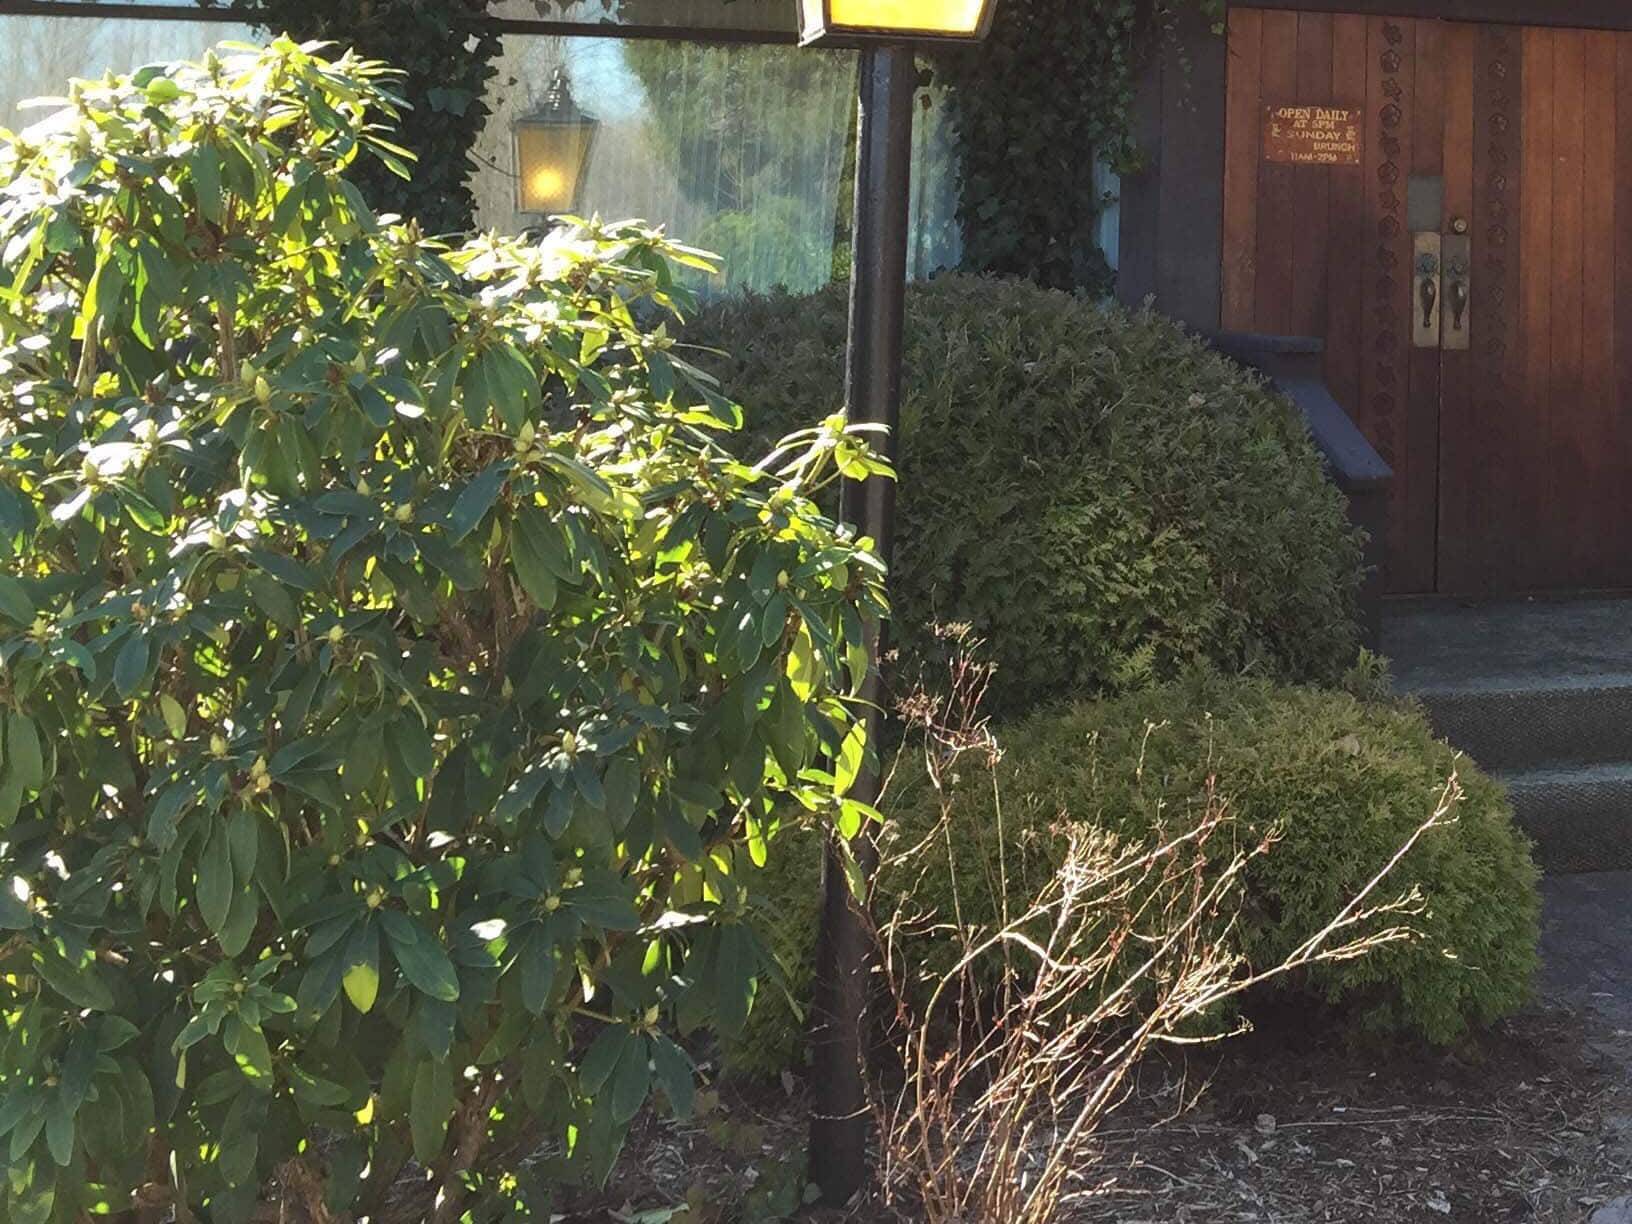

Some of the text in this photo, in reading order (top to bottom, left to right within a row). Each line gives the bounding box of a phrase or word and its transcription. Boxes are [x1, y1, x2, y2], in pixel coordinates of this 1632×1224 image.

[1279, 107, 1349, 121] OPEN DAILY
[1292, 119, 1307, 128] AT
[1286, 130, 1340, 140] SUNDAY
[1313, 142, 1355, 152] BRUNCH
